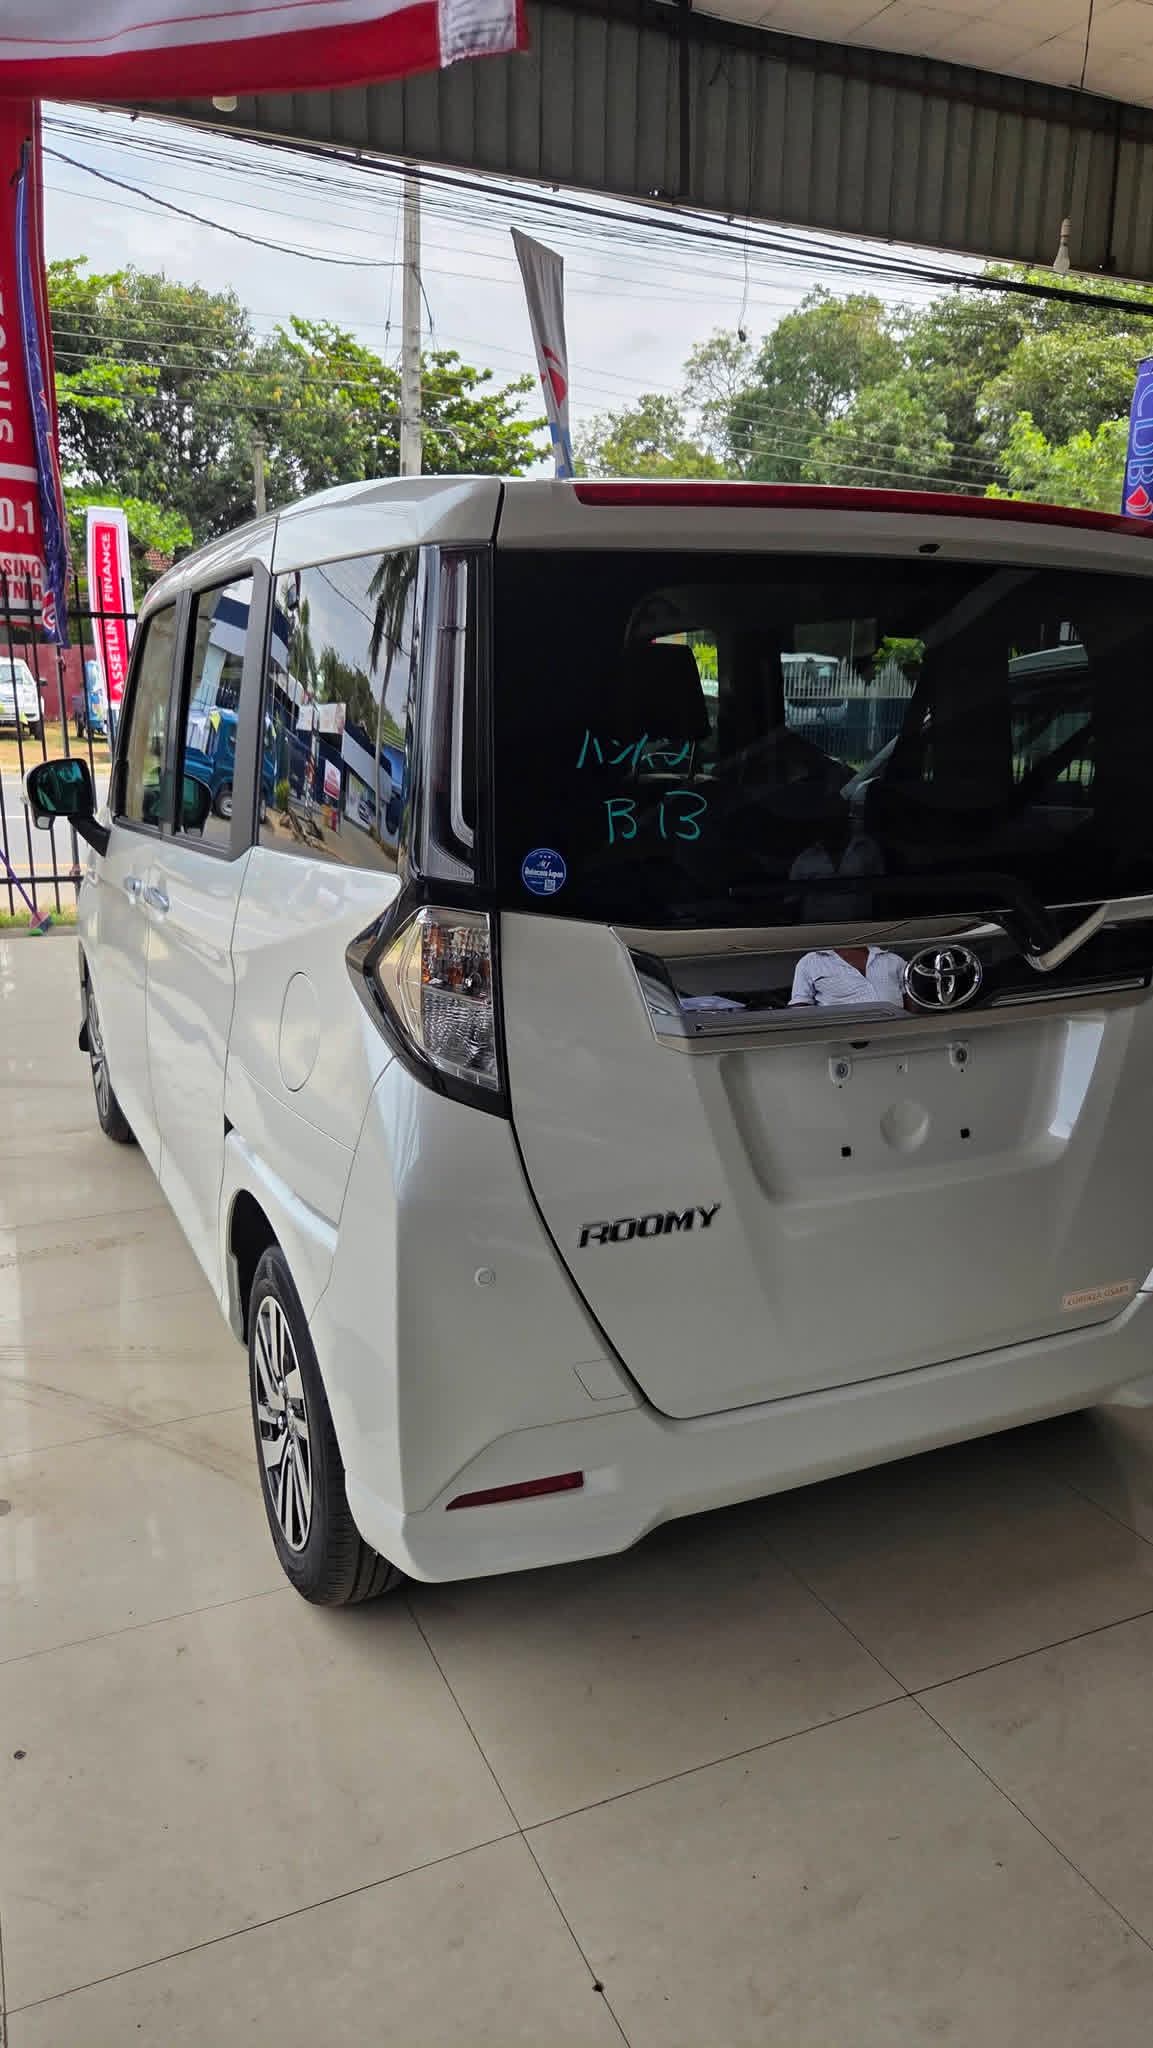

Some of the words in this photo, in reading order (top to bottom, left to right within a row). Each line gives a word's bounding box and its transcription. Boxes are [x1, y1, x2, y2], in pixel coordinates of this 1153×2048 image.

[101, 532, 113, 602] FINANCE
[104, 609, 124, 693] ASSETLIN
[603, 797, 637, 845] B
[577, 1201, 722, 1248] ROOMY
